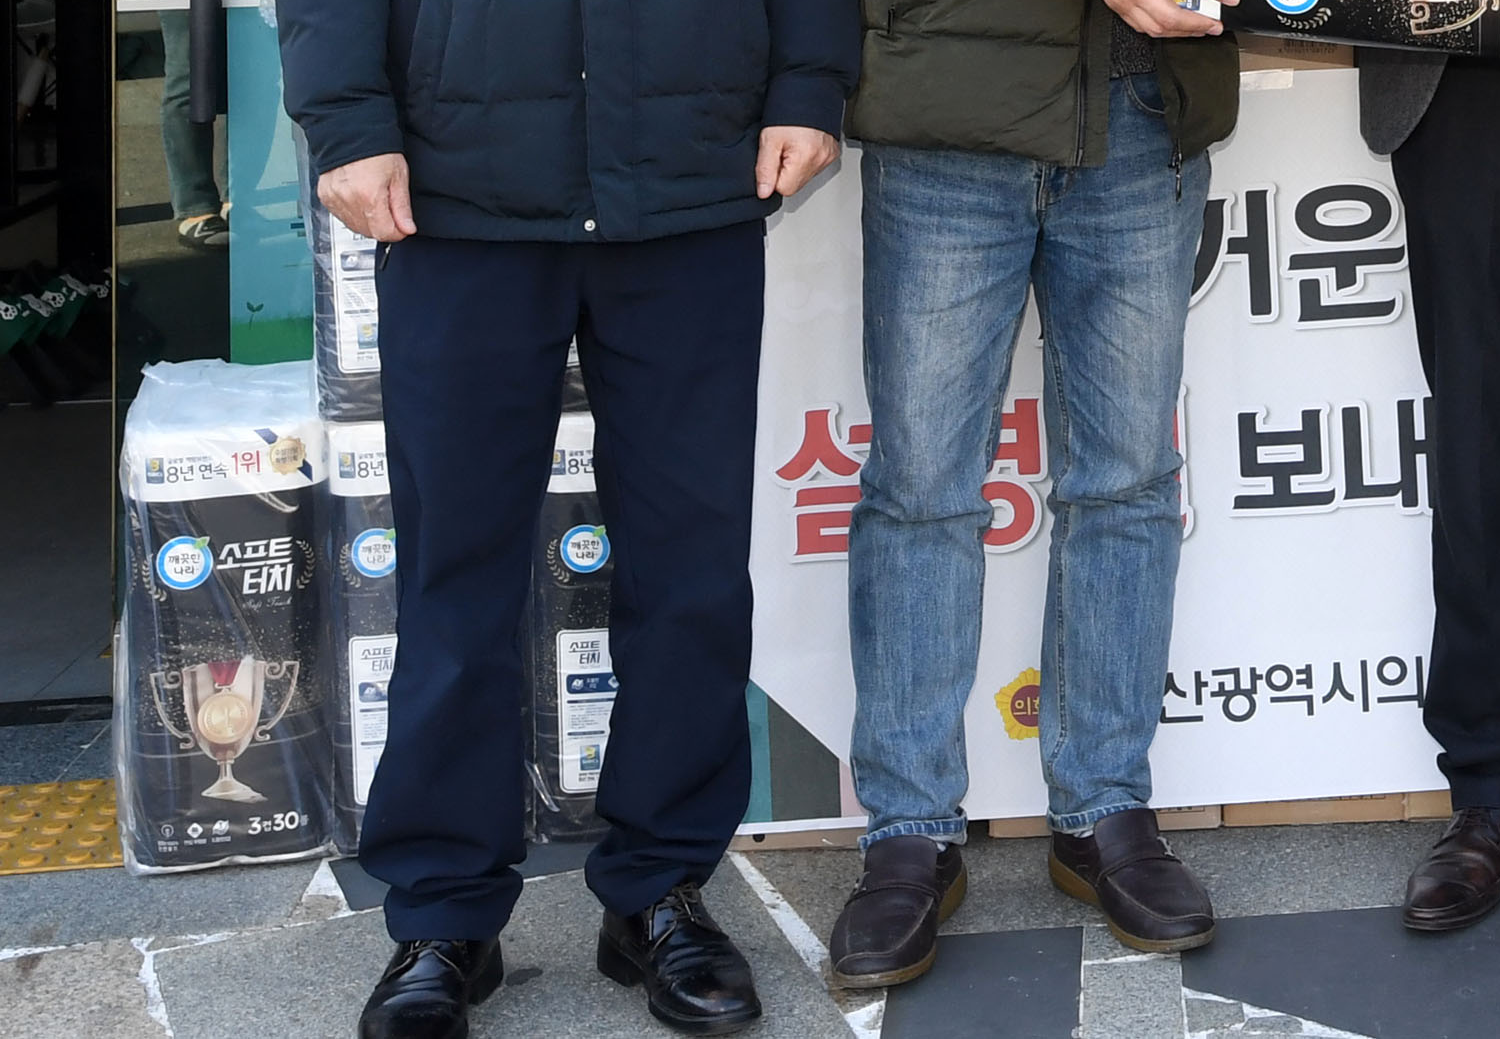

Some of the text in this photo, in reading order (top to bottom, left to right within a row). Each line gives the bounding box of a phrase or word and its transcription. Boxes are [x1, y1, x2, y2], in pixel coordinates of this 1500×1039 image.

[167, 449, 261, 484] 8년 연속 1위
[357, 460, 385, 479] 8년
[168, 553, 201, 566] 깨끗한
[216, 536, 293, 570] 소프트
[173, 565, 196, 576] 나라
[242, 564, 293, 596] 터치
[1160, 654, 1426, 724] 산광역시의
